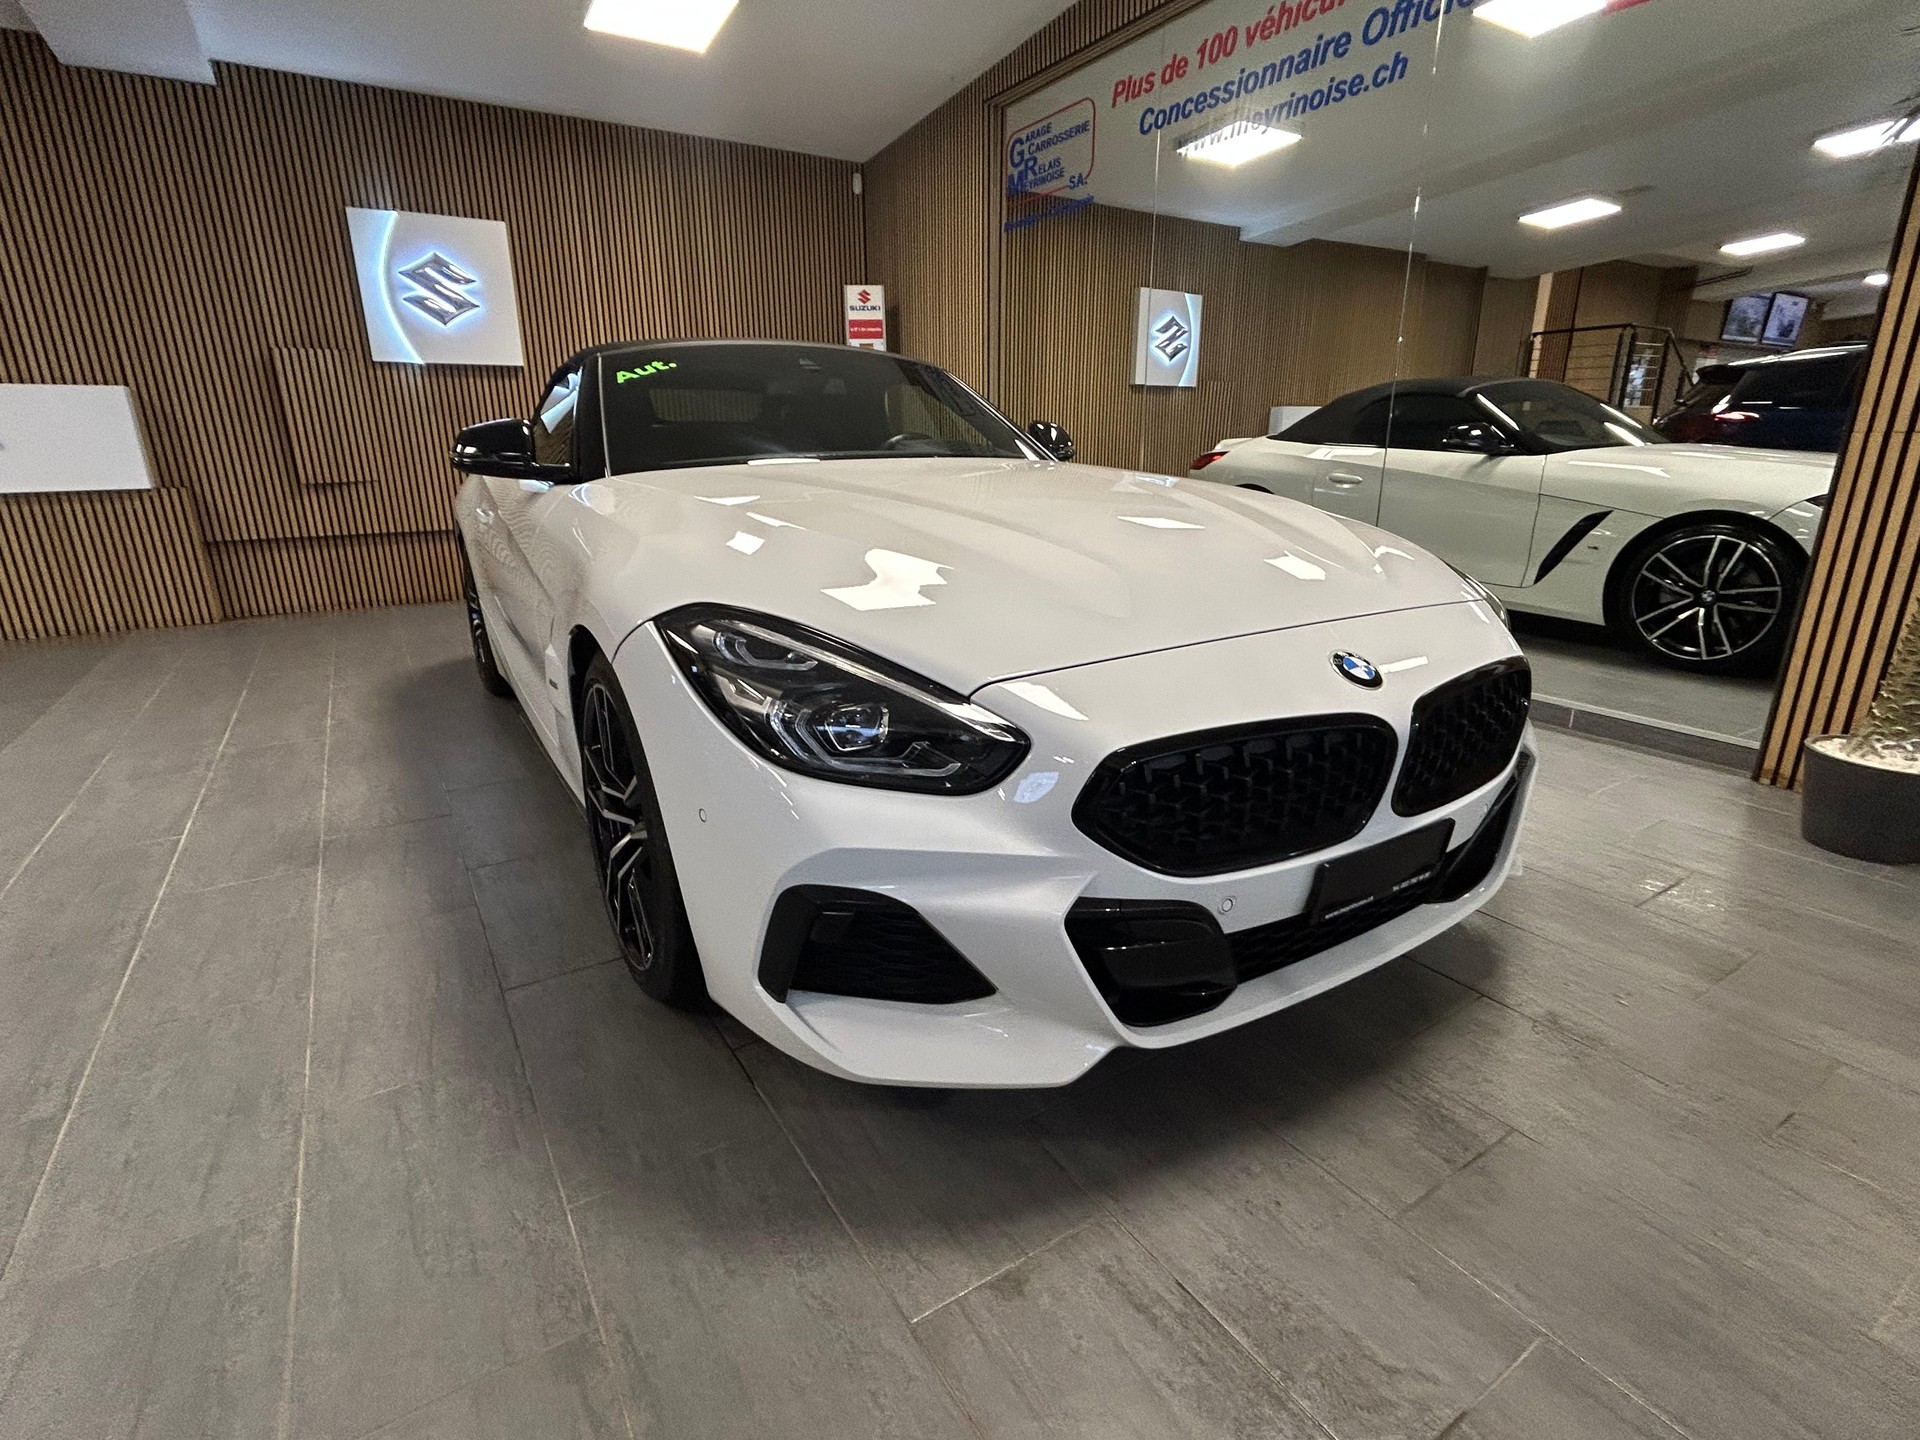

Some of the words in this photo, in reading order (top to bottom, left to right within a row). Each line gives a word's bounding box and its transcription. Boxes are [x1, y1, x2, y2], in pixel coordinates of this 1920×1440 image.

[1111, 70, 1158, 109] Plus
[1160, 53, 1189, 86] de
[1196, 25, 1239, 69] 100
[1245, 0, 1346, 48] véhicu
[1139, 31, 1352, 136] Concessionnaire
[1027, 120, 1091, 156] CARROSSERIE
[849, 304, 881, 312] SUZUKI
[616, 361, 678, 384] Aut.
